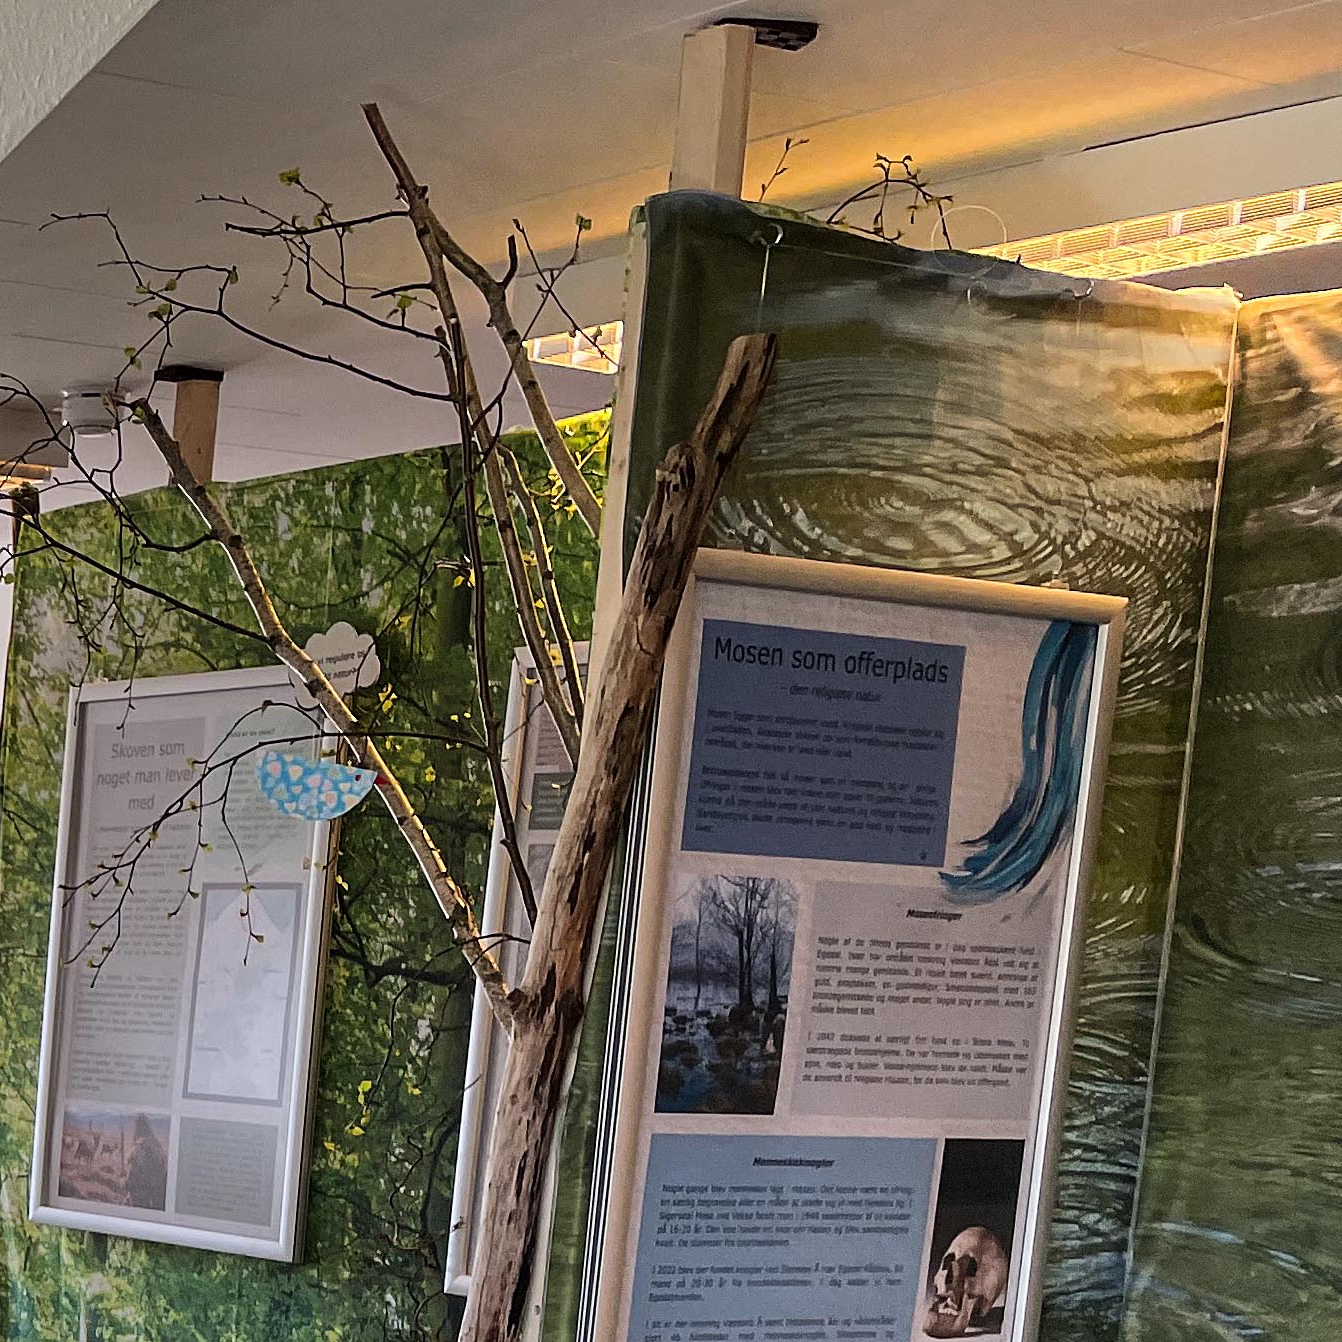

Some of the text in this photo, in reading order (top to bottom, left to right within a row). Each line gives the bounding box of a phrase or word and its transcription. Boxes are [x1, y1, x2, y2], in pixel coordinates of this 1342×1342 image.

[715, 637, 948, 684] Mosen som offerplads
[112, 742, 185, 758] Skoven som
[97, 771, 130, 788] noget
[134, 771, 161, 784] man
[129, 796, 155, 810] med
